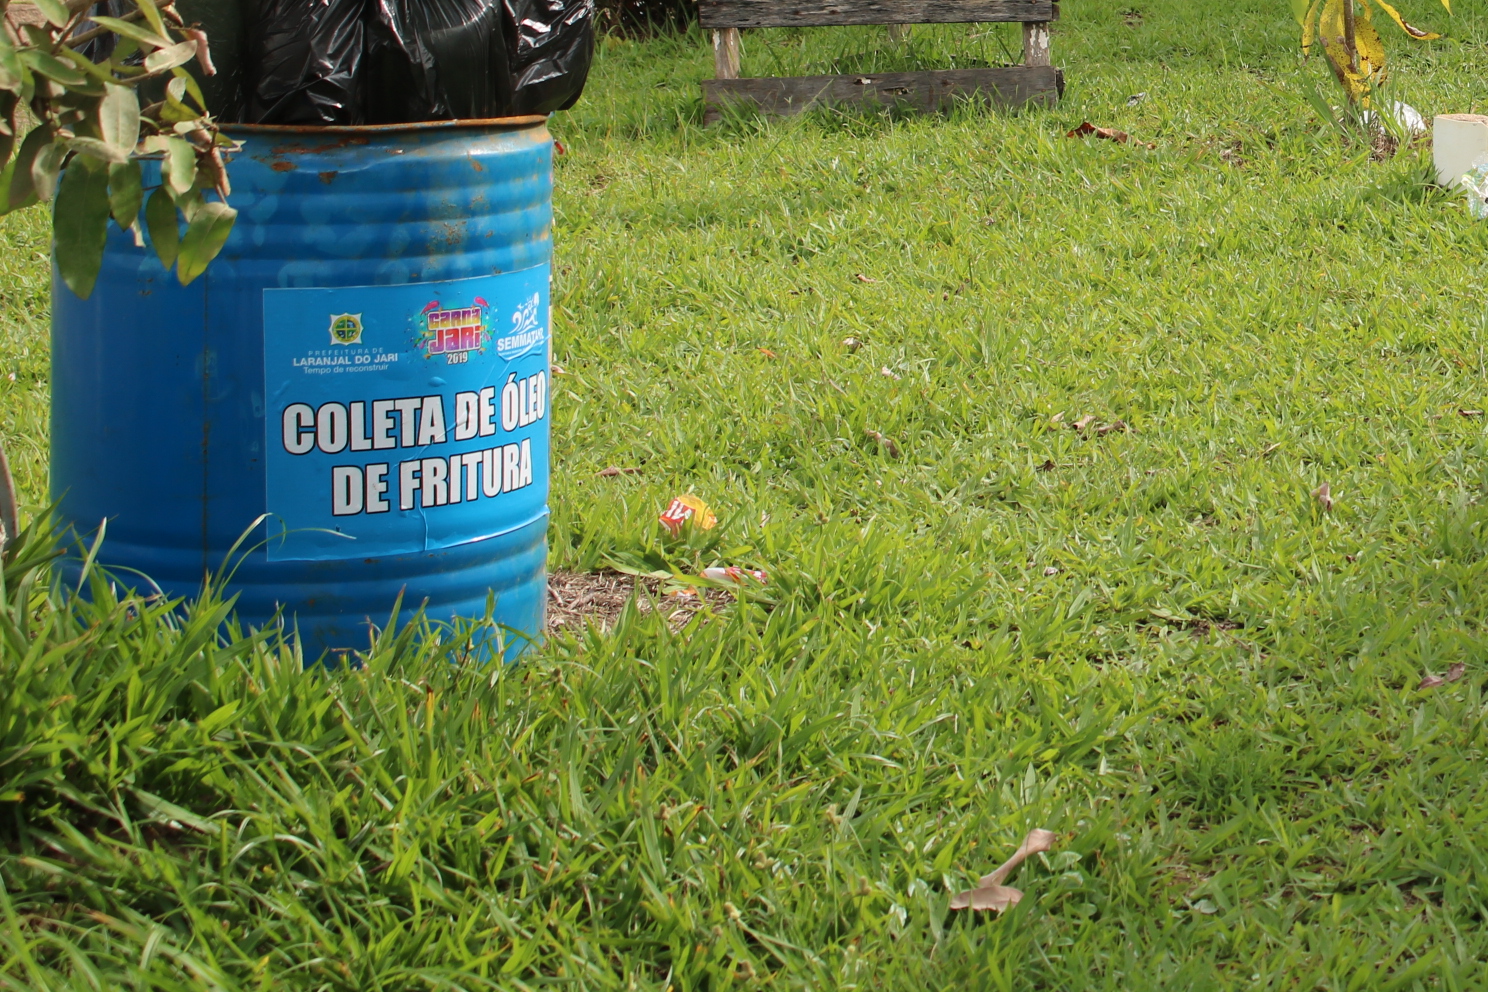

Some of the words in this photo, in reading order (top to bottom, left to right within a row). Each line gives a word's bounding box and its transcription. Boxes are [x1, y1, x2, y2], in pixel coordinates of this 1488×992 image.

[308, 348, 370, 356] PREFEITURA
[446, 352, 468, 365] 2019
[292, 355, 352, 367] LARANJAL
[354, 354, 371, 365] DO
[373, 352, 398, 364] JARI
[303, 366, 333, 376] Tempo
[333, 365, 348, 374] de
[348, 363, 389, 373] reconstruir
[282, 394, 447, 455] COLETA
[454, 385, 496, 441] DE
[501, 369, 547, 432] ÓLEO
[331, 462, 390, 516] DE
[399, 437, 534, 510] FRITURA
